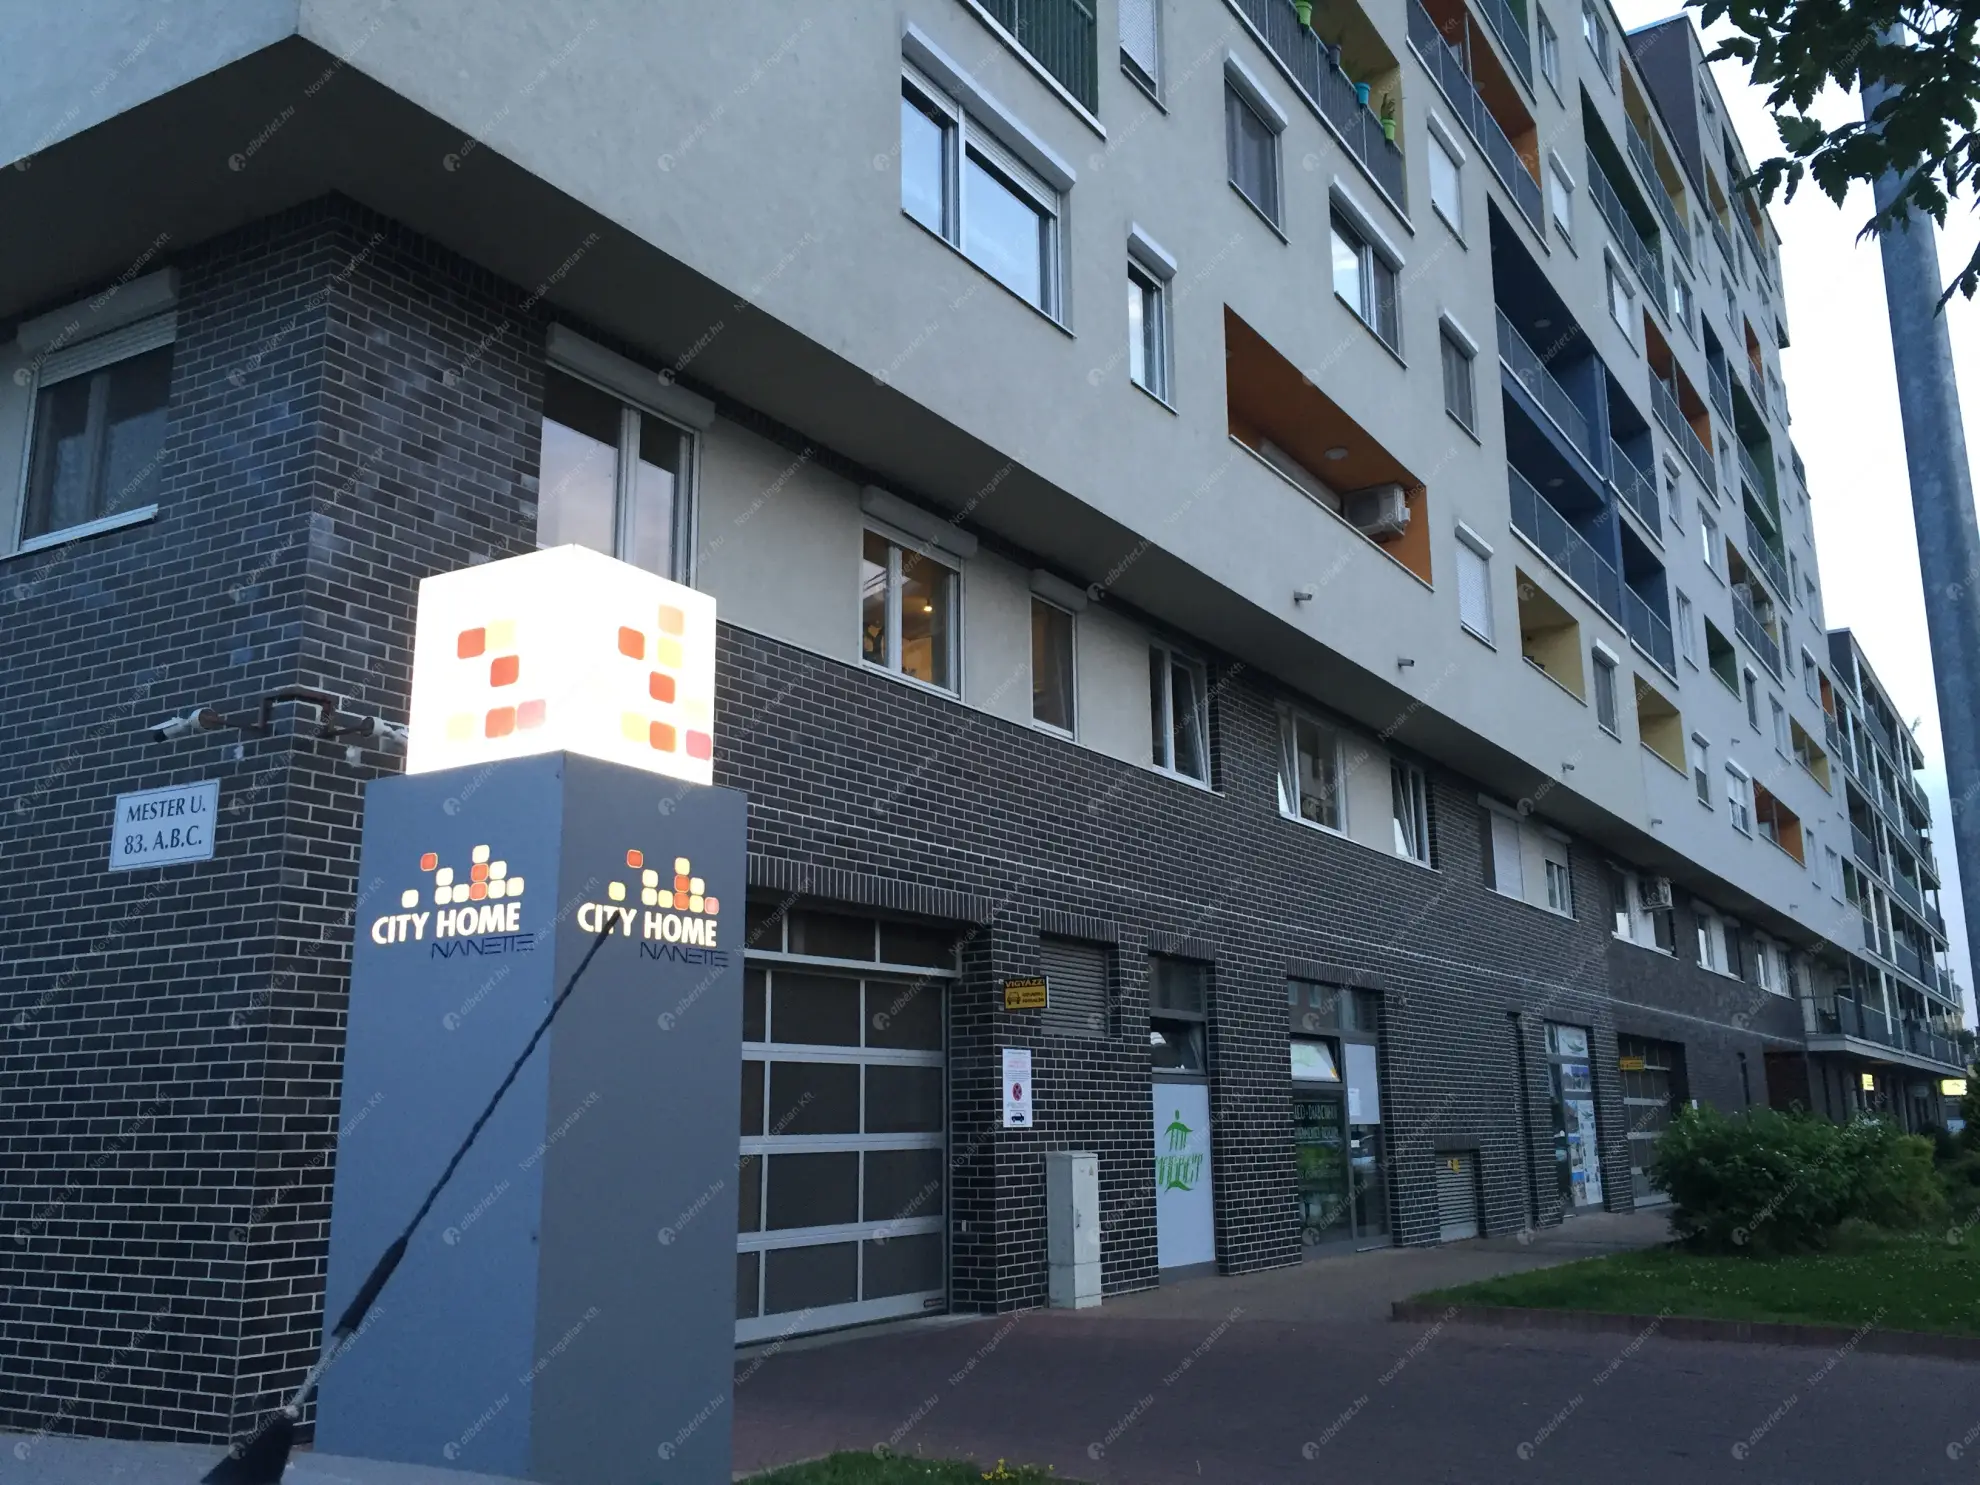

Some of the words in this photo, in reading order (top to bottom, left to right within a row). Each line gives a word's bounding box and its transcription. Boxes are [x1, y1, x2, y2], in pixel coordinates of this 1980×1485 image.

[126, 797, 186, 823] MESTER
[190, 795, 206, 814] U.
[124, 834, 148, 855] 83.
[152, 825, 202, 851] A.B.C.
[371, 911, 430, 944] CITY
[436, 902, 521, 938] HOME
[577, 902, 637, 937] CITY
[644, 911, 717, 947] HOME
[431, 933, 534, 960] NANETTE
[640, 941, 729, 967] NANETTE
